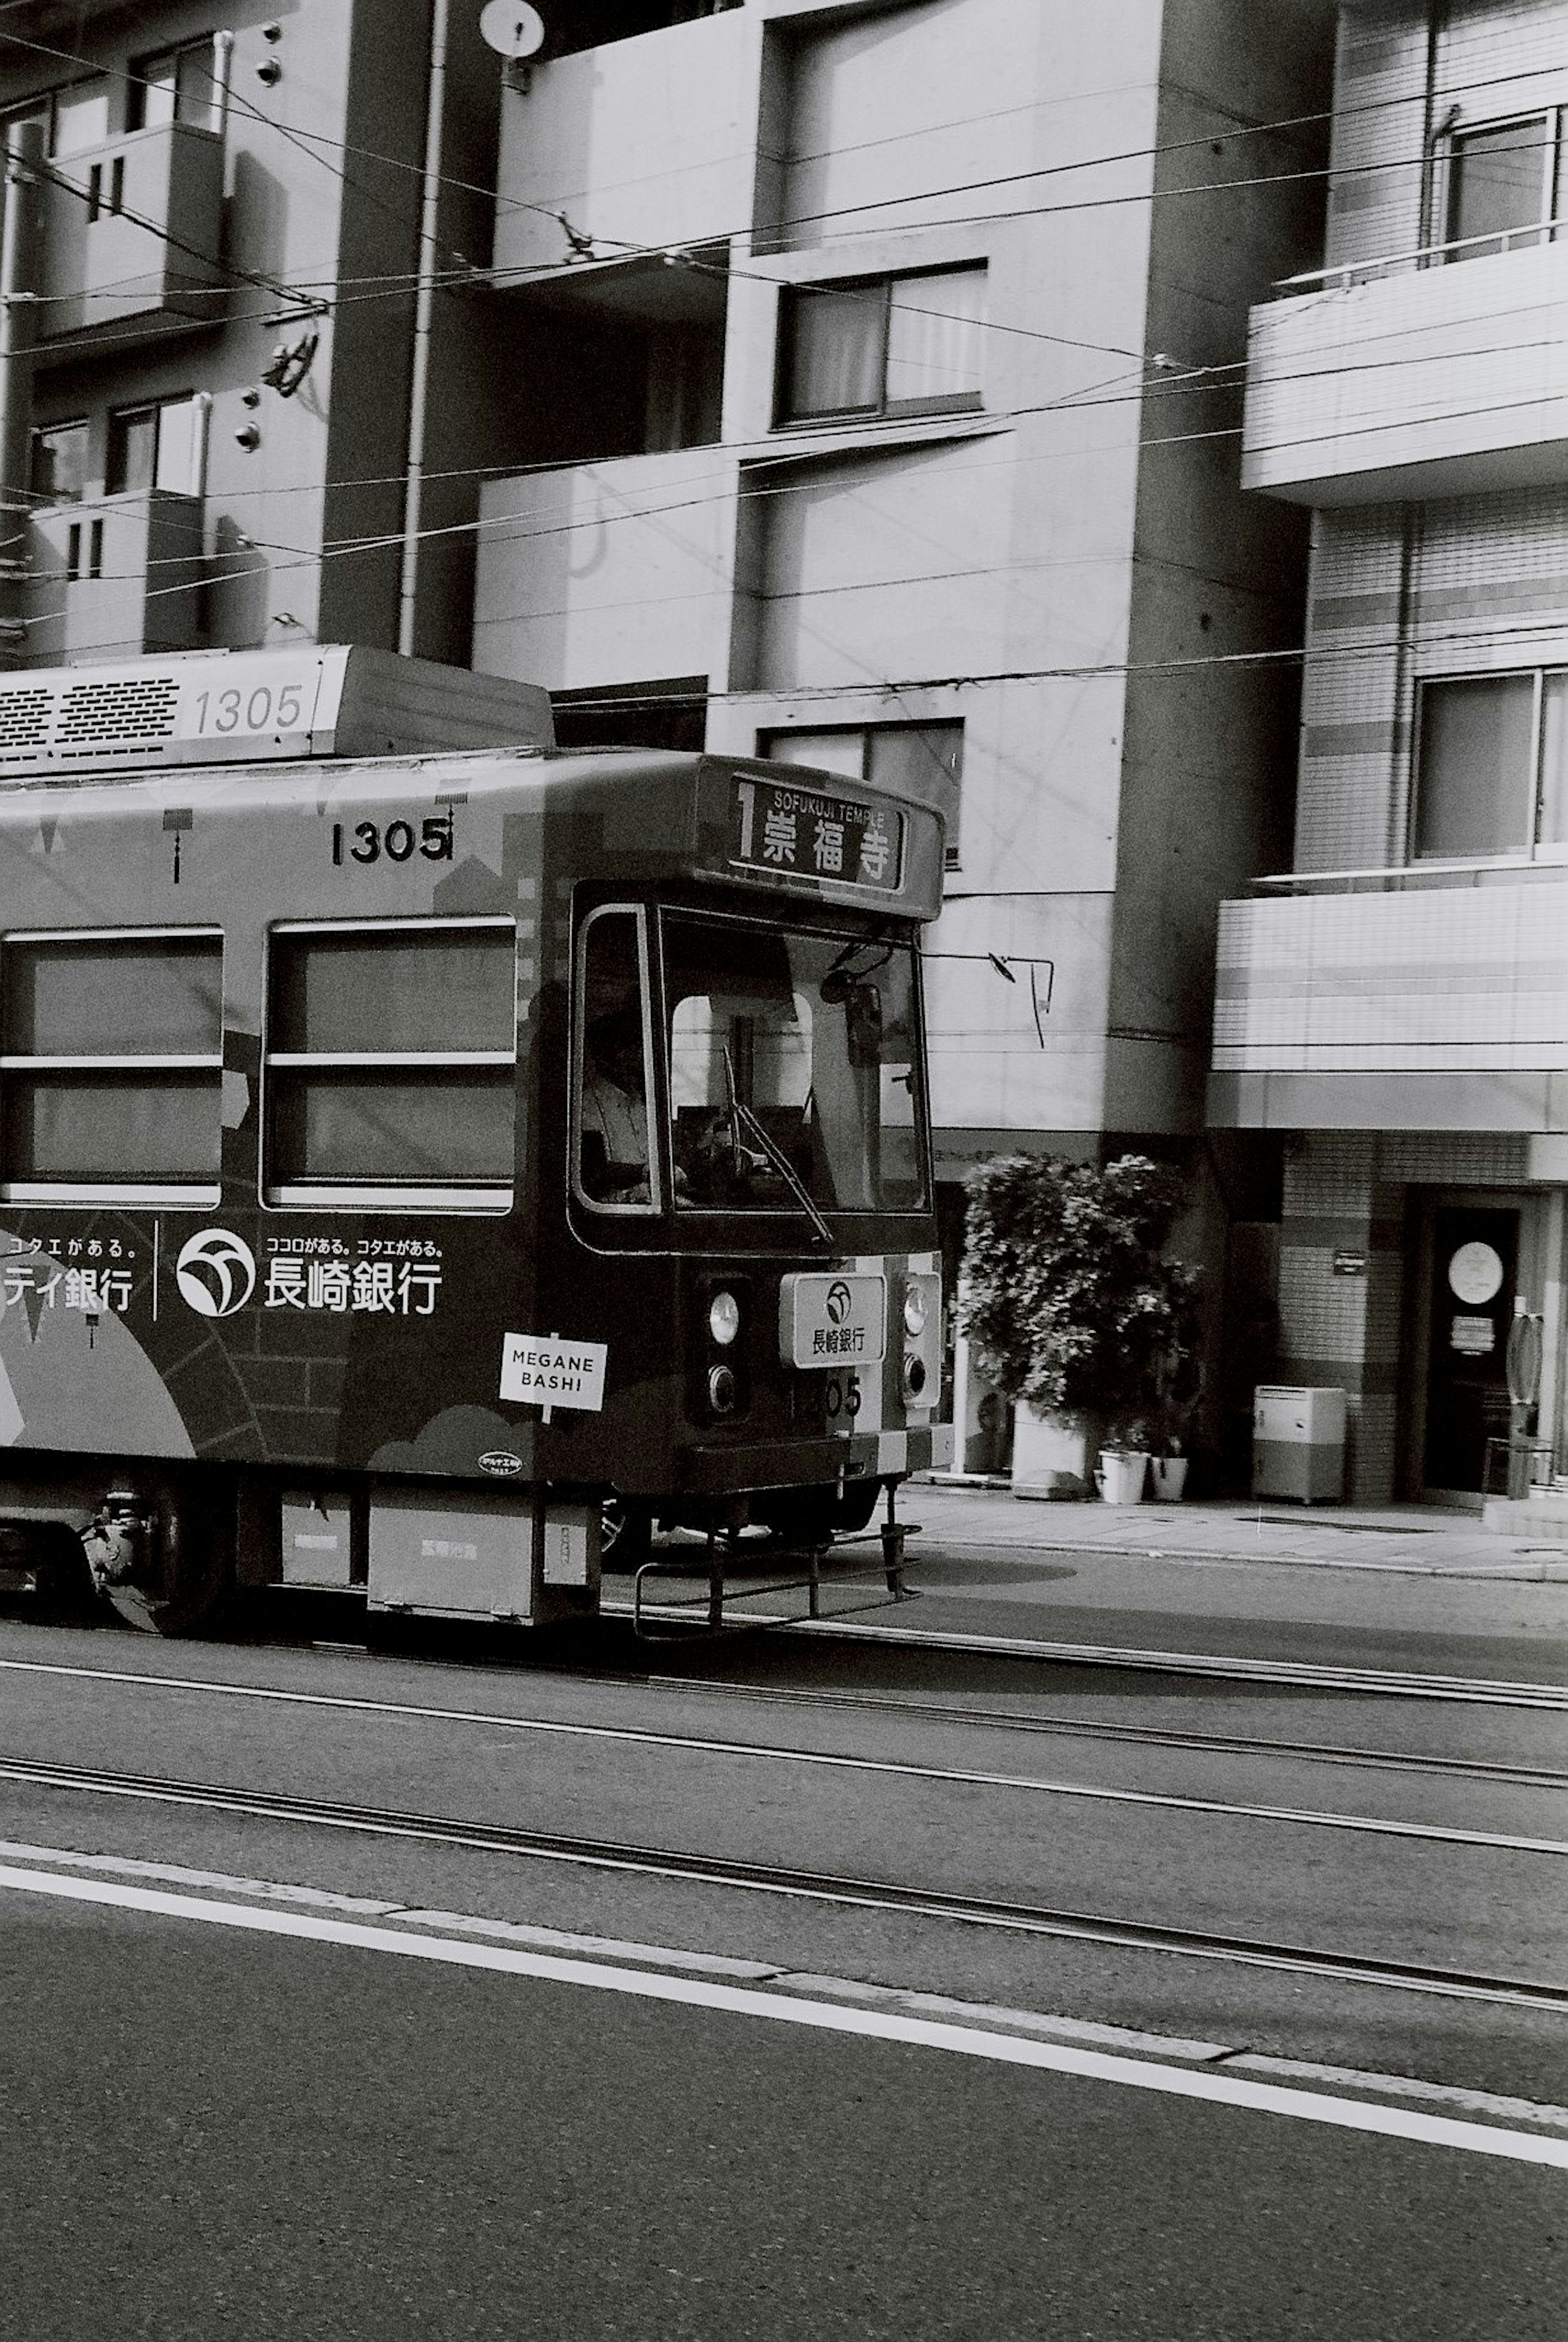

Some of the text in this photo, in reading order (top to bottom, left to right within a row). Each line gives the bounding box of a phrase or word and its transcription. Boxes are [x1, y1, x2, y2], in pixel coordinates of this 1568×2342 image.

[195, 685, 302, 733] 1305
[737, 782, 755, 858] 1
[774, 791, 884, 829] SOFUKUJI TEMPLE
[332, 817, 453, 866] 1305
[763, 809, 890, 880] 崇福寺
[8, 1237, 136, 1259] コタエがある。
[4, 1267, 133, 1312] ティ銀行
[264, 1257, 443, 1315] 長崎銀行
[512, 1350, 593, 1372] MEGANE
[813, 1328, 865, 1355] 長崎銀行
[521, 1372, 581, 1391] BASHI
